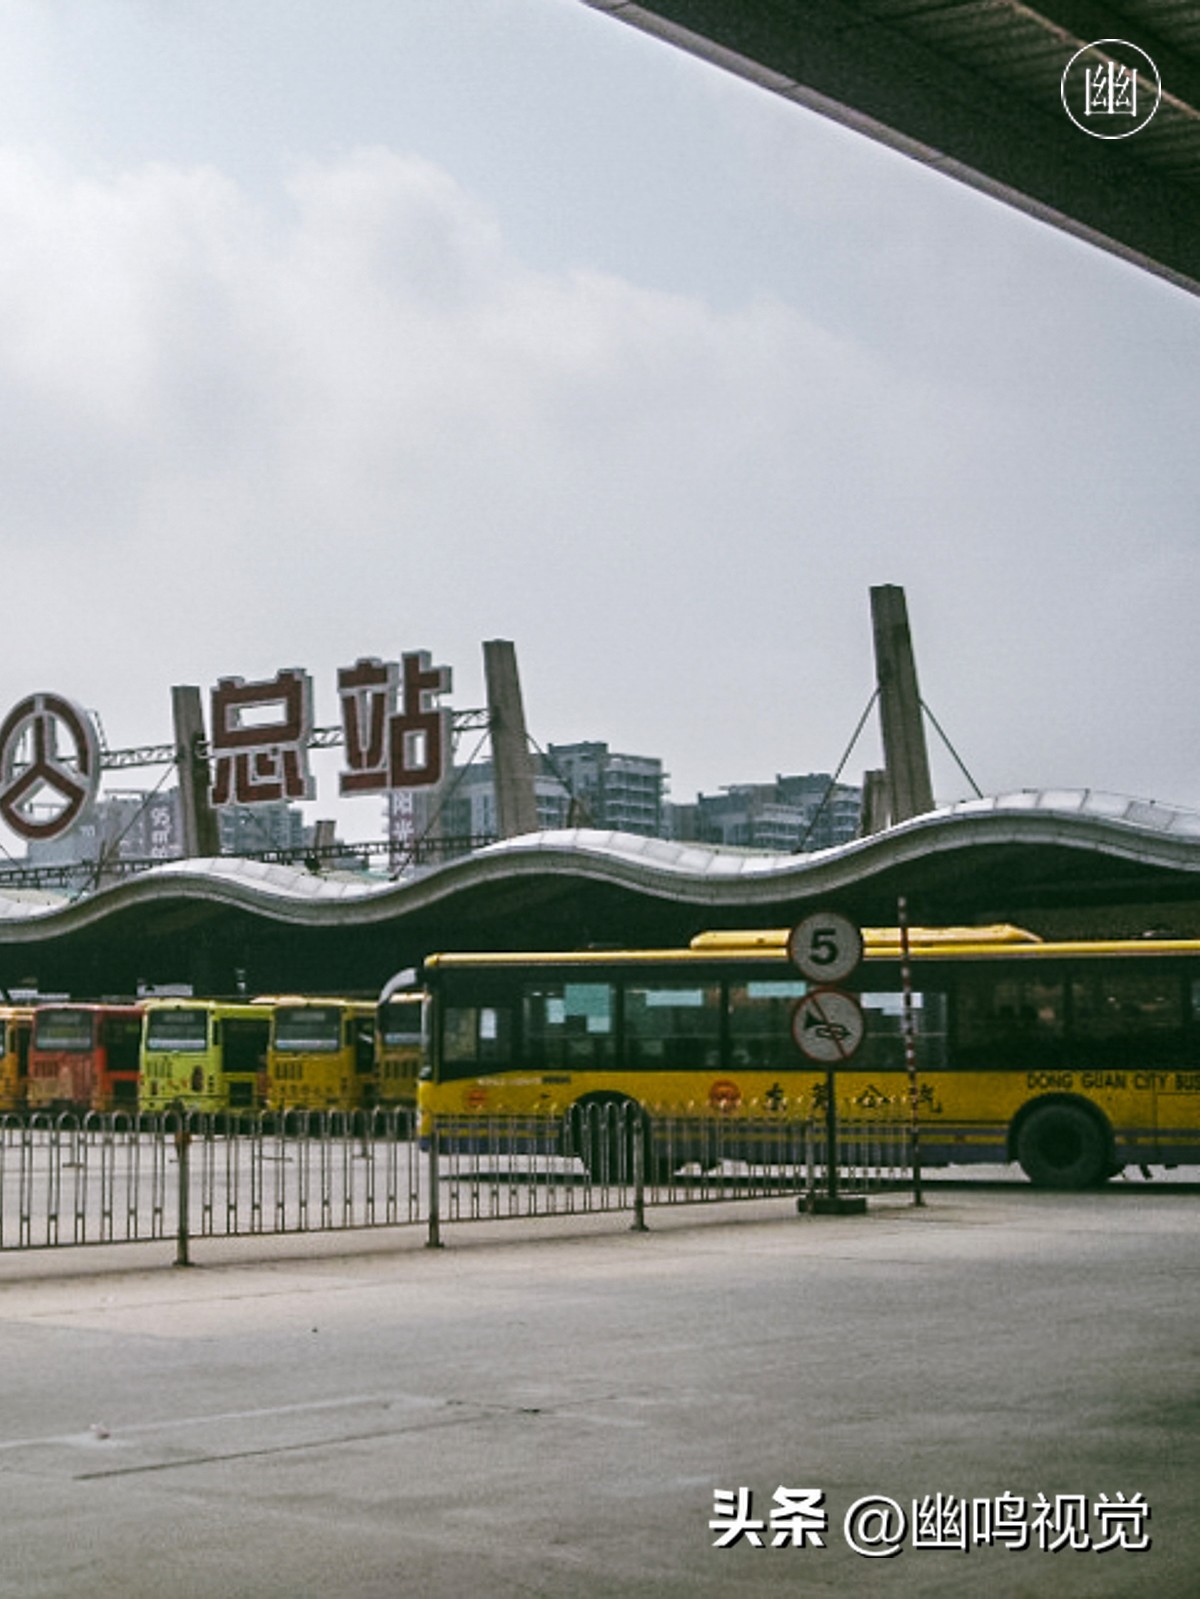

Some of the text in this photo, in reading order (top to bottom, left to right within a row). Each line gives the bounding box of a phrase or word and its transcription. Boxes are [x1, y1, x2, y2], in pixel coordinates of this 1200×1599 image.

[207, 650, 453, 808] 总站
[809, 927, 839, 966] 5
[1027, 1071, 1073, 1089] DONG
[1081, 1071, 1127, 1089] GUAN
[1134, 1072, 1171, 1090] CITY
